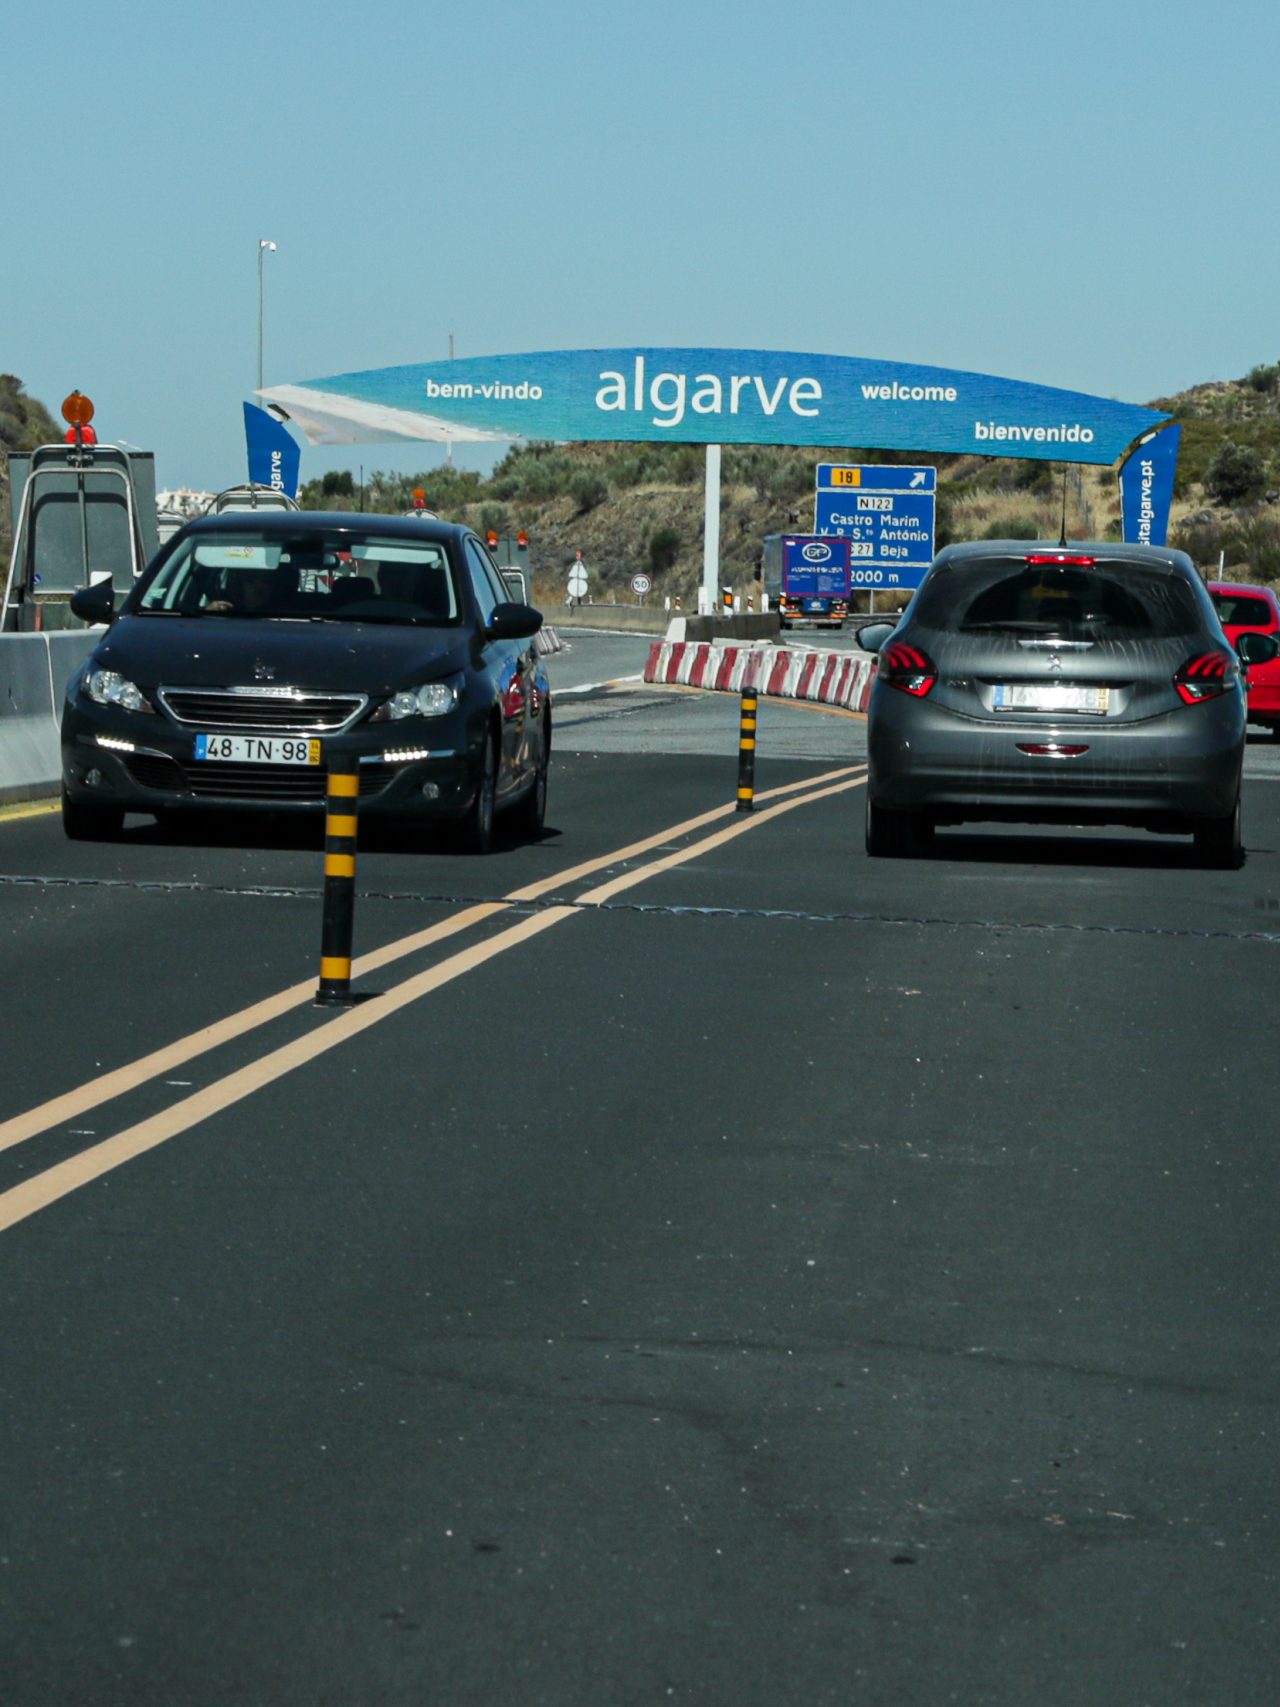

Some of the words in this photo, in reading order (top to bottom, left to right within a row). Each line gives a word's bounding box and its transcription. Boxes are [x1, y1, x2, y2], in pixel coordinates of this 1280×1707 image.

[426, 379, 543, 400] bem-vindo
[595, 356, 822, 427] algarve
[861, 381, 957, 402] welcome
[975, 422, 1094, 443] bienvenido
[271, 450, 285, 490] garve
[839, 471, 853, 484] 18
[1137, 460, 1155, 547] sitalgarve.pt
[830, 513, 873, 526] Castro
[880, 514, 919, 527] Marim
[880, 529, 929, 541] António
[880, 544, 909, 559] Beja
[850, 570, 883, 583] 2000
[888, 574, 899, 583] m
